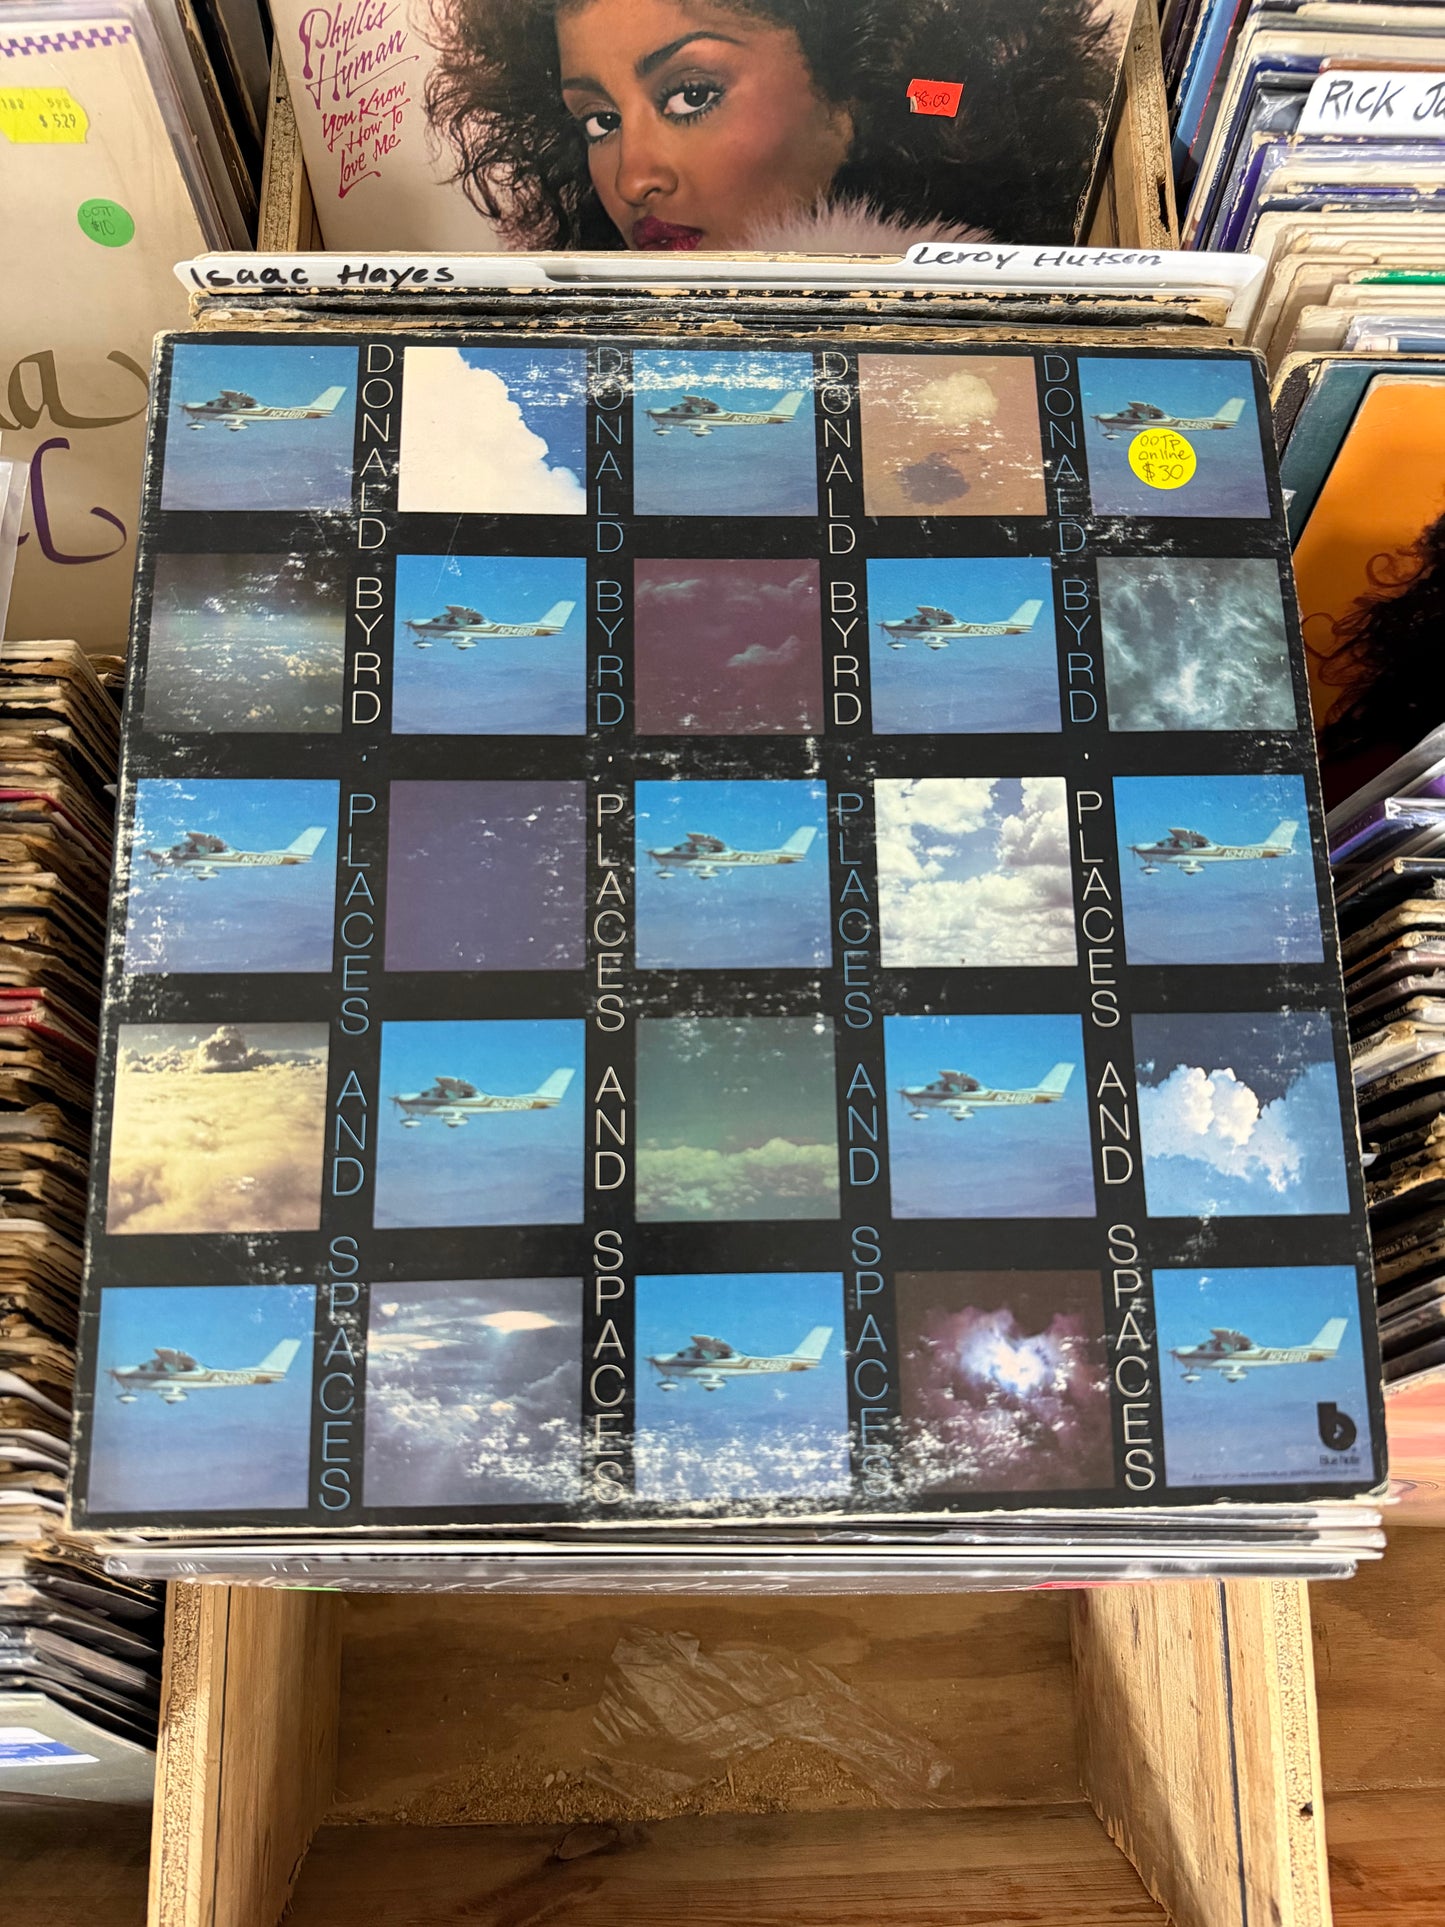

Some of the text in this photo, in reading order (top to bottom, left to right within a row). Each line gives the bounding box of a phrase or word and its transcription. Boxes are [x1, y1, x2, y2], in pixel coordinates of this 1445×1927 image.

[299, 0, 401, 79] Phyllis
[305, 30, 419, 110] Hyman
[345, 121, 382, 153] How
[358, 81, 407, 122] Know
[338, 134, 401, 199] Love Me
[190, 263, 455, 289] Isaac Hayes
[912, 246, 1020, 270] Leroy
[1142, 461, 1184, 482] $30
[318, 344, 394, 1511] DONALD BYRD PLACES AND SPACES
[590, 346, 627, 1505] DONALD BYRD PLACES AND SPACES
[821, 351, 892, 1497] DONALD BYRD PLACES AND SPACES
[1043, 355, 1157, 1491] DONALD BYRD PLACES AND SPACES
